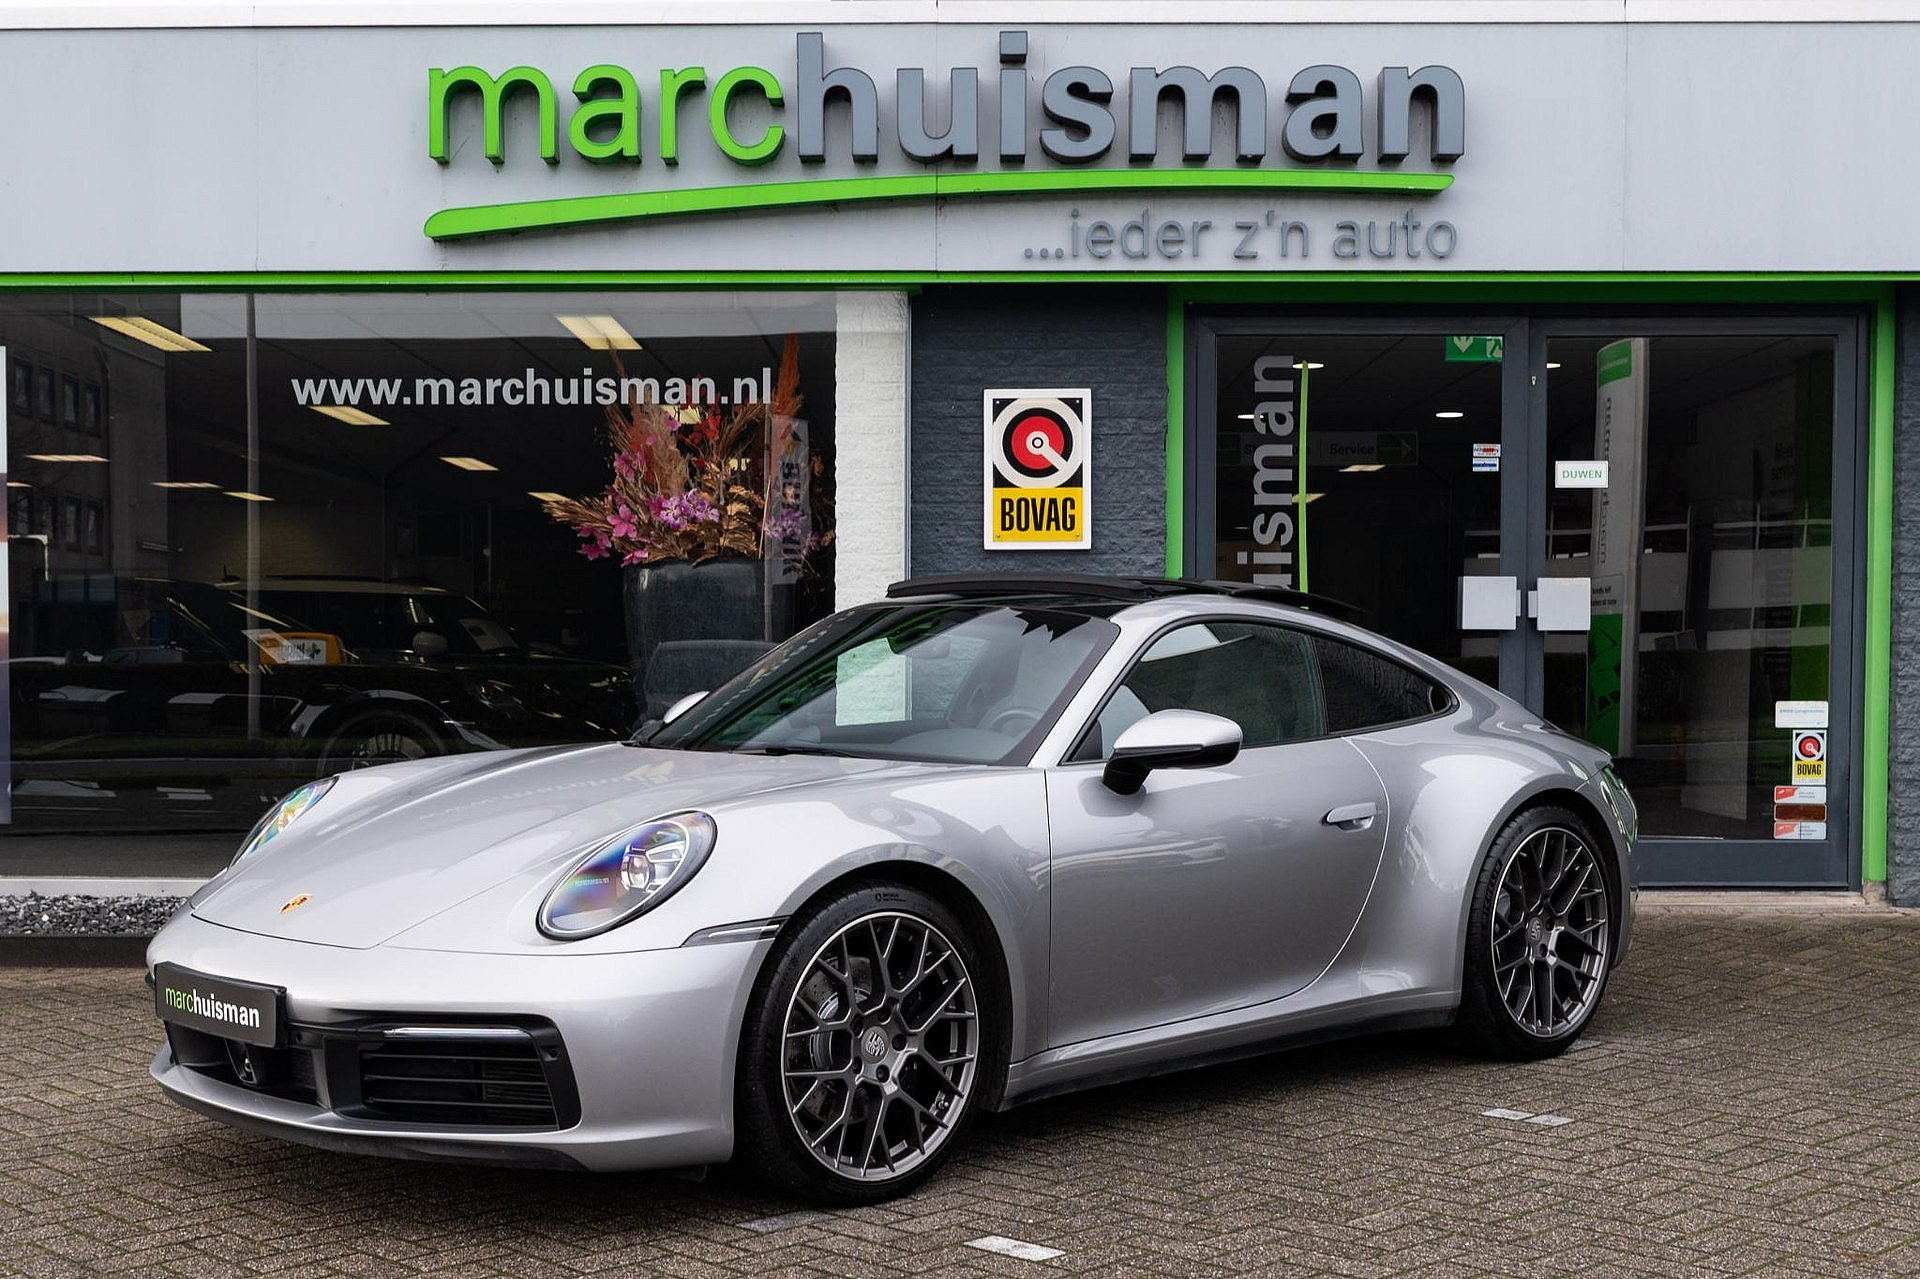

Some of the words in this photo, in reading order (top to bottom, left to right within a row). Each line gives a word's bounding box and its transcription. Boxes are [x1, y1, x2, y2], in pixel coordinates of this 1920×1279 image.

[428, 31, 1465, 166] marchuisman
[1234, 210, 1310, 259] z'n
[1333, 208, 1457, 259] auto
[291, 368, 772, 406] www.marchuisman.nl
[1329, 443, 1375, 456] Service
[1562, 470, 1602, 479] DUWEN
[1000, 497, 1076, 532] BOVAG
[1797, 764, 1822, 776] BOVAG
[165, 987, 260, 1028] marchuisman
